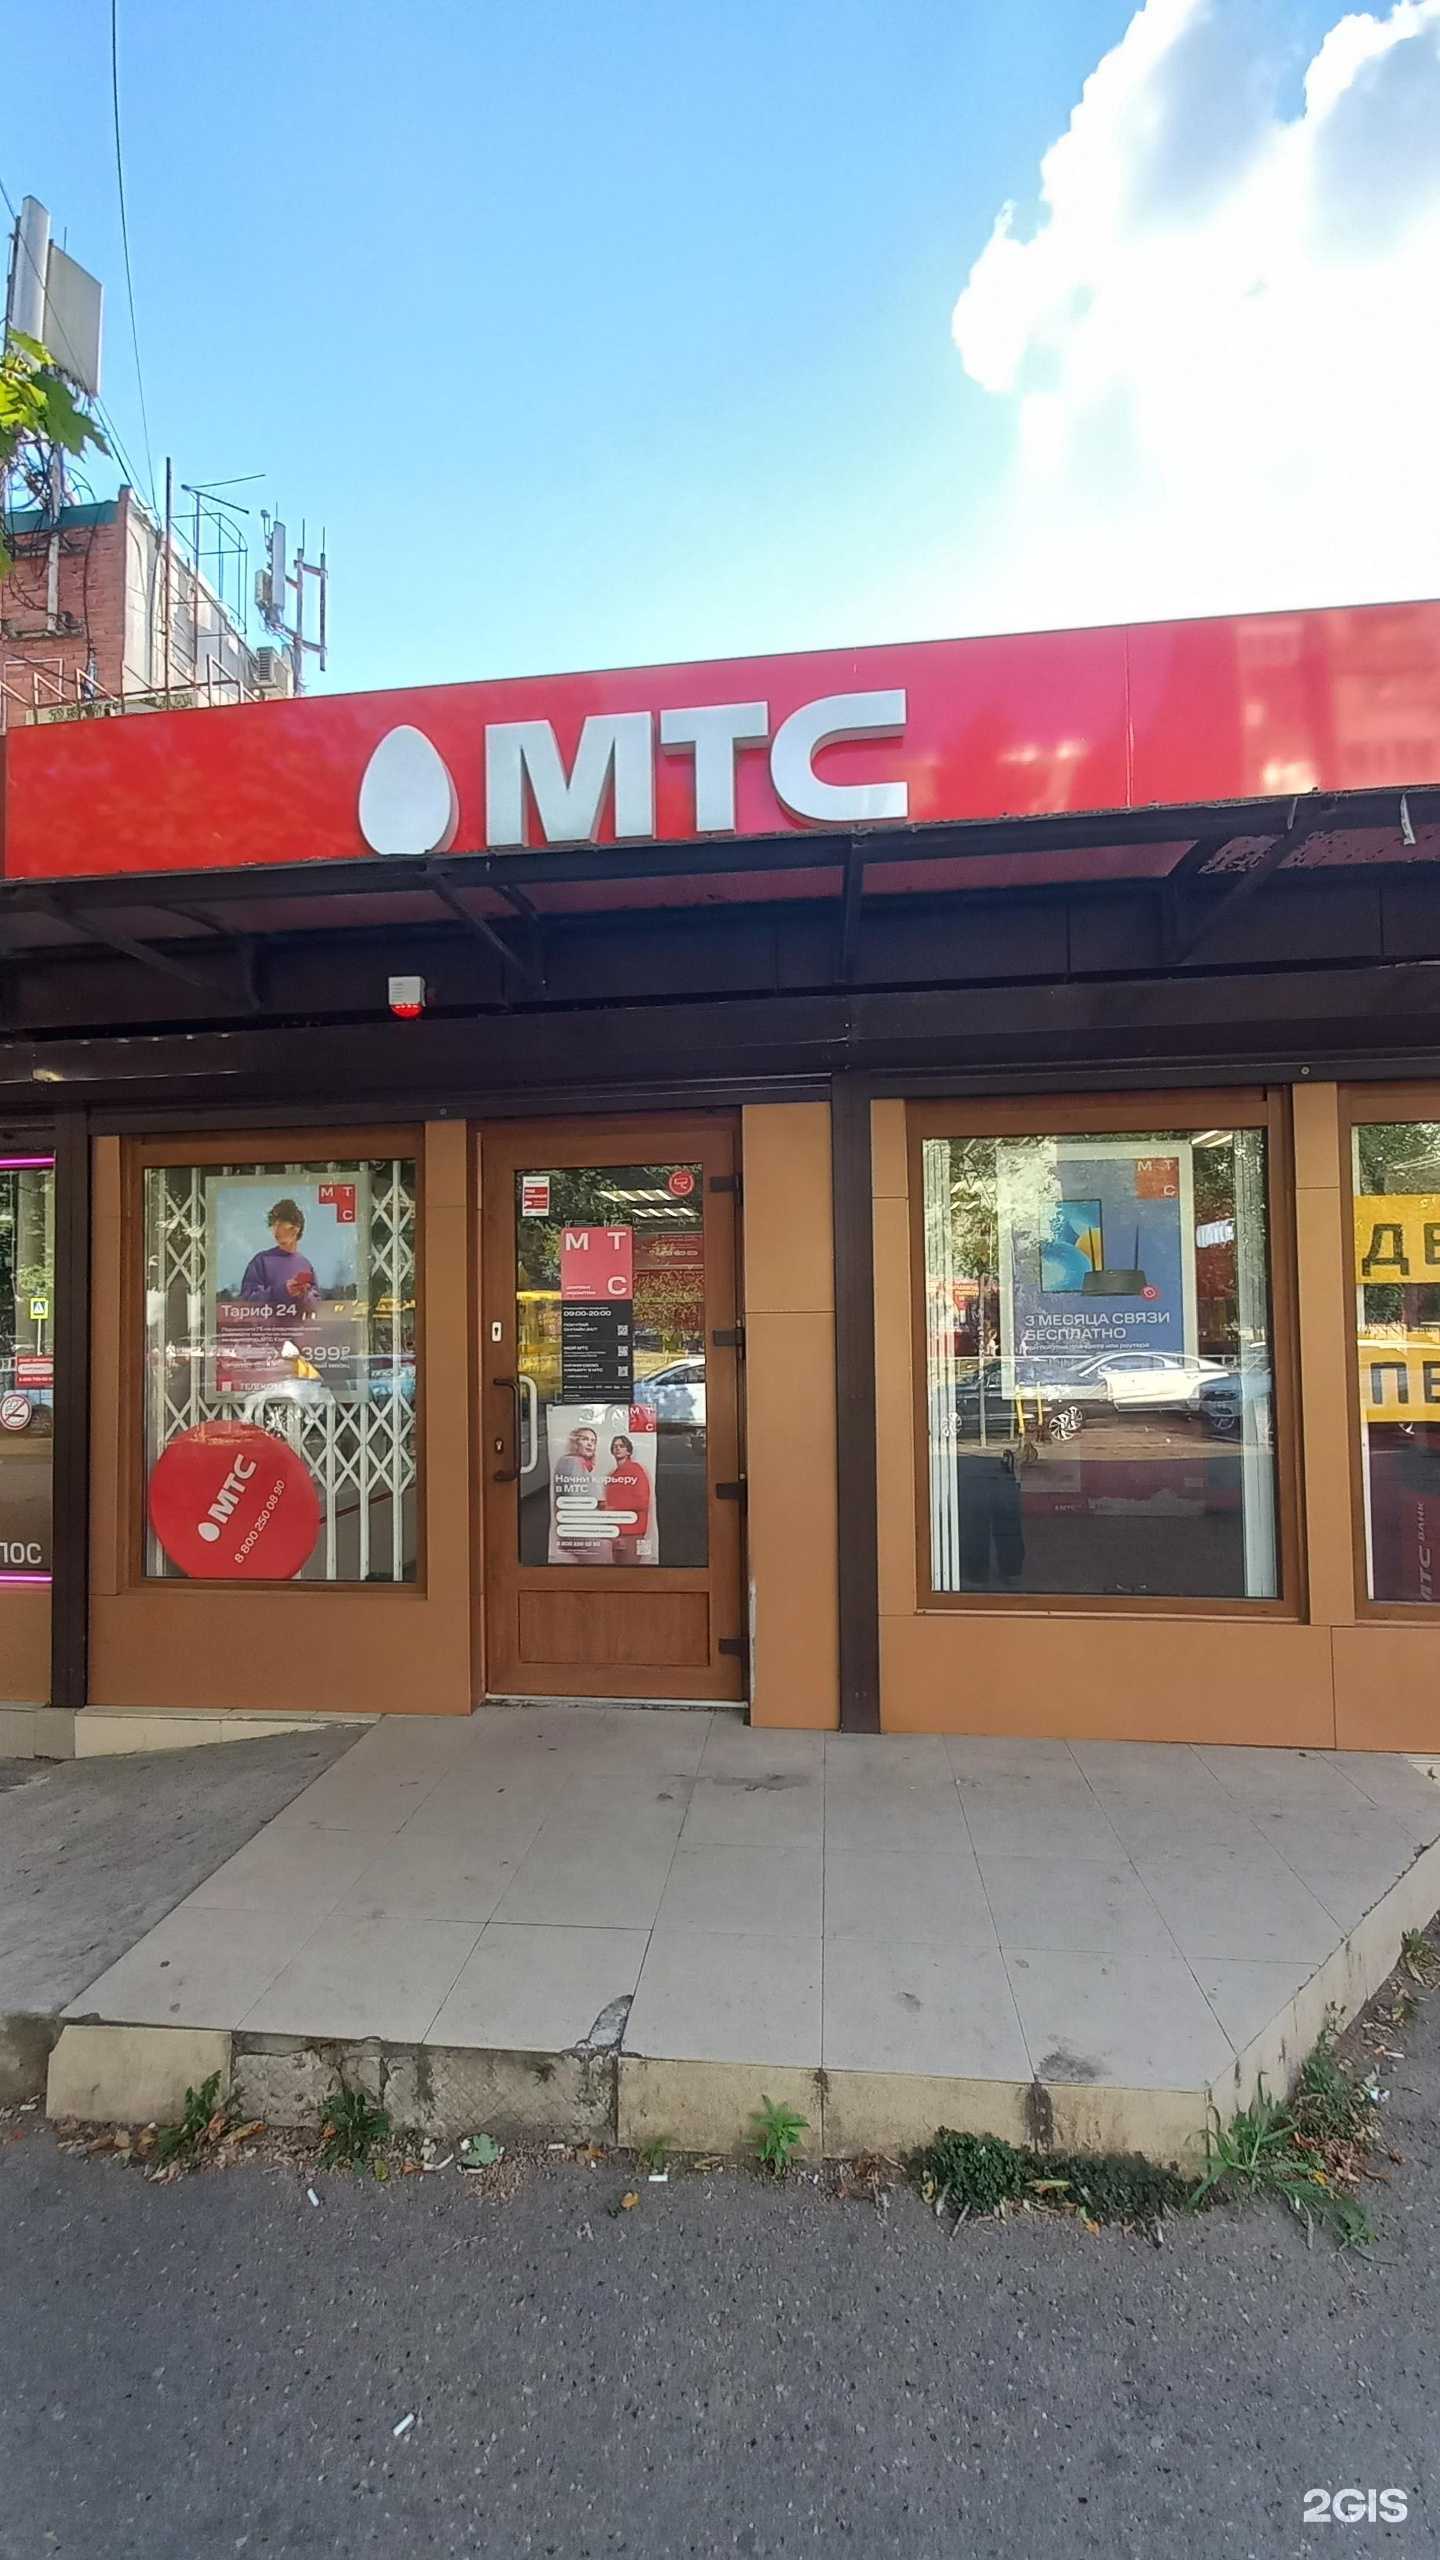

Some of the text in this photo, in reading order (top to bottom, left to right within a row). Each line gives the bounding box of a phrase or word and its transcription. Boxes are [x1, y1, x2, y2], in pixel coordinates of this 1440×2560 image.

[485, 688, 909, 848] МТС
[221, 1304, 297, 1319] Тариф 24
[1025, 1312, 1170, 1328] 3 МЕСЯЦА СВЯЗИ
[1024, 1327, 1126, 1341] БЕСПЛАТНО
[555, 1474, 590, 1484] Начни
[208, 1453, 257, 1524] МТС
[564, 1484, 589, 1493] МТС
[234, 1480, 286, 1563] 8 800 250 08 90
